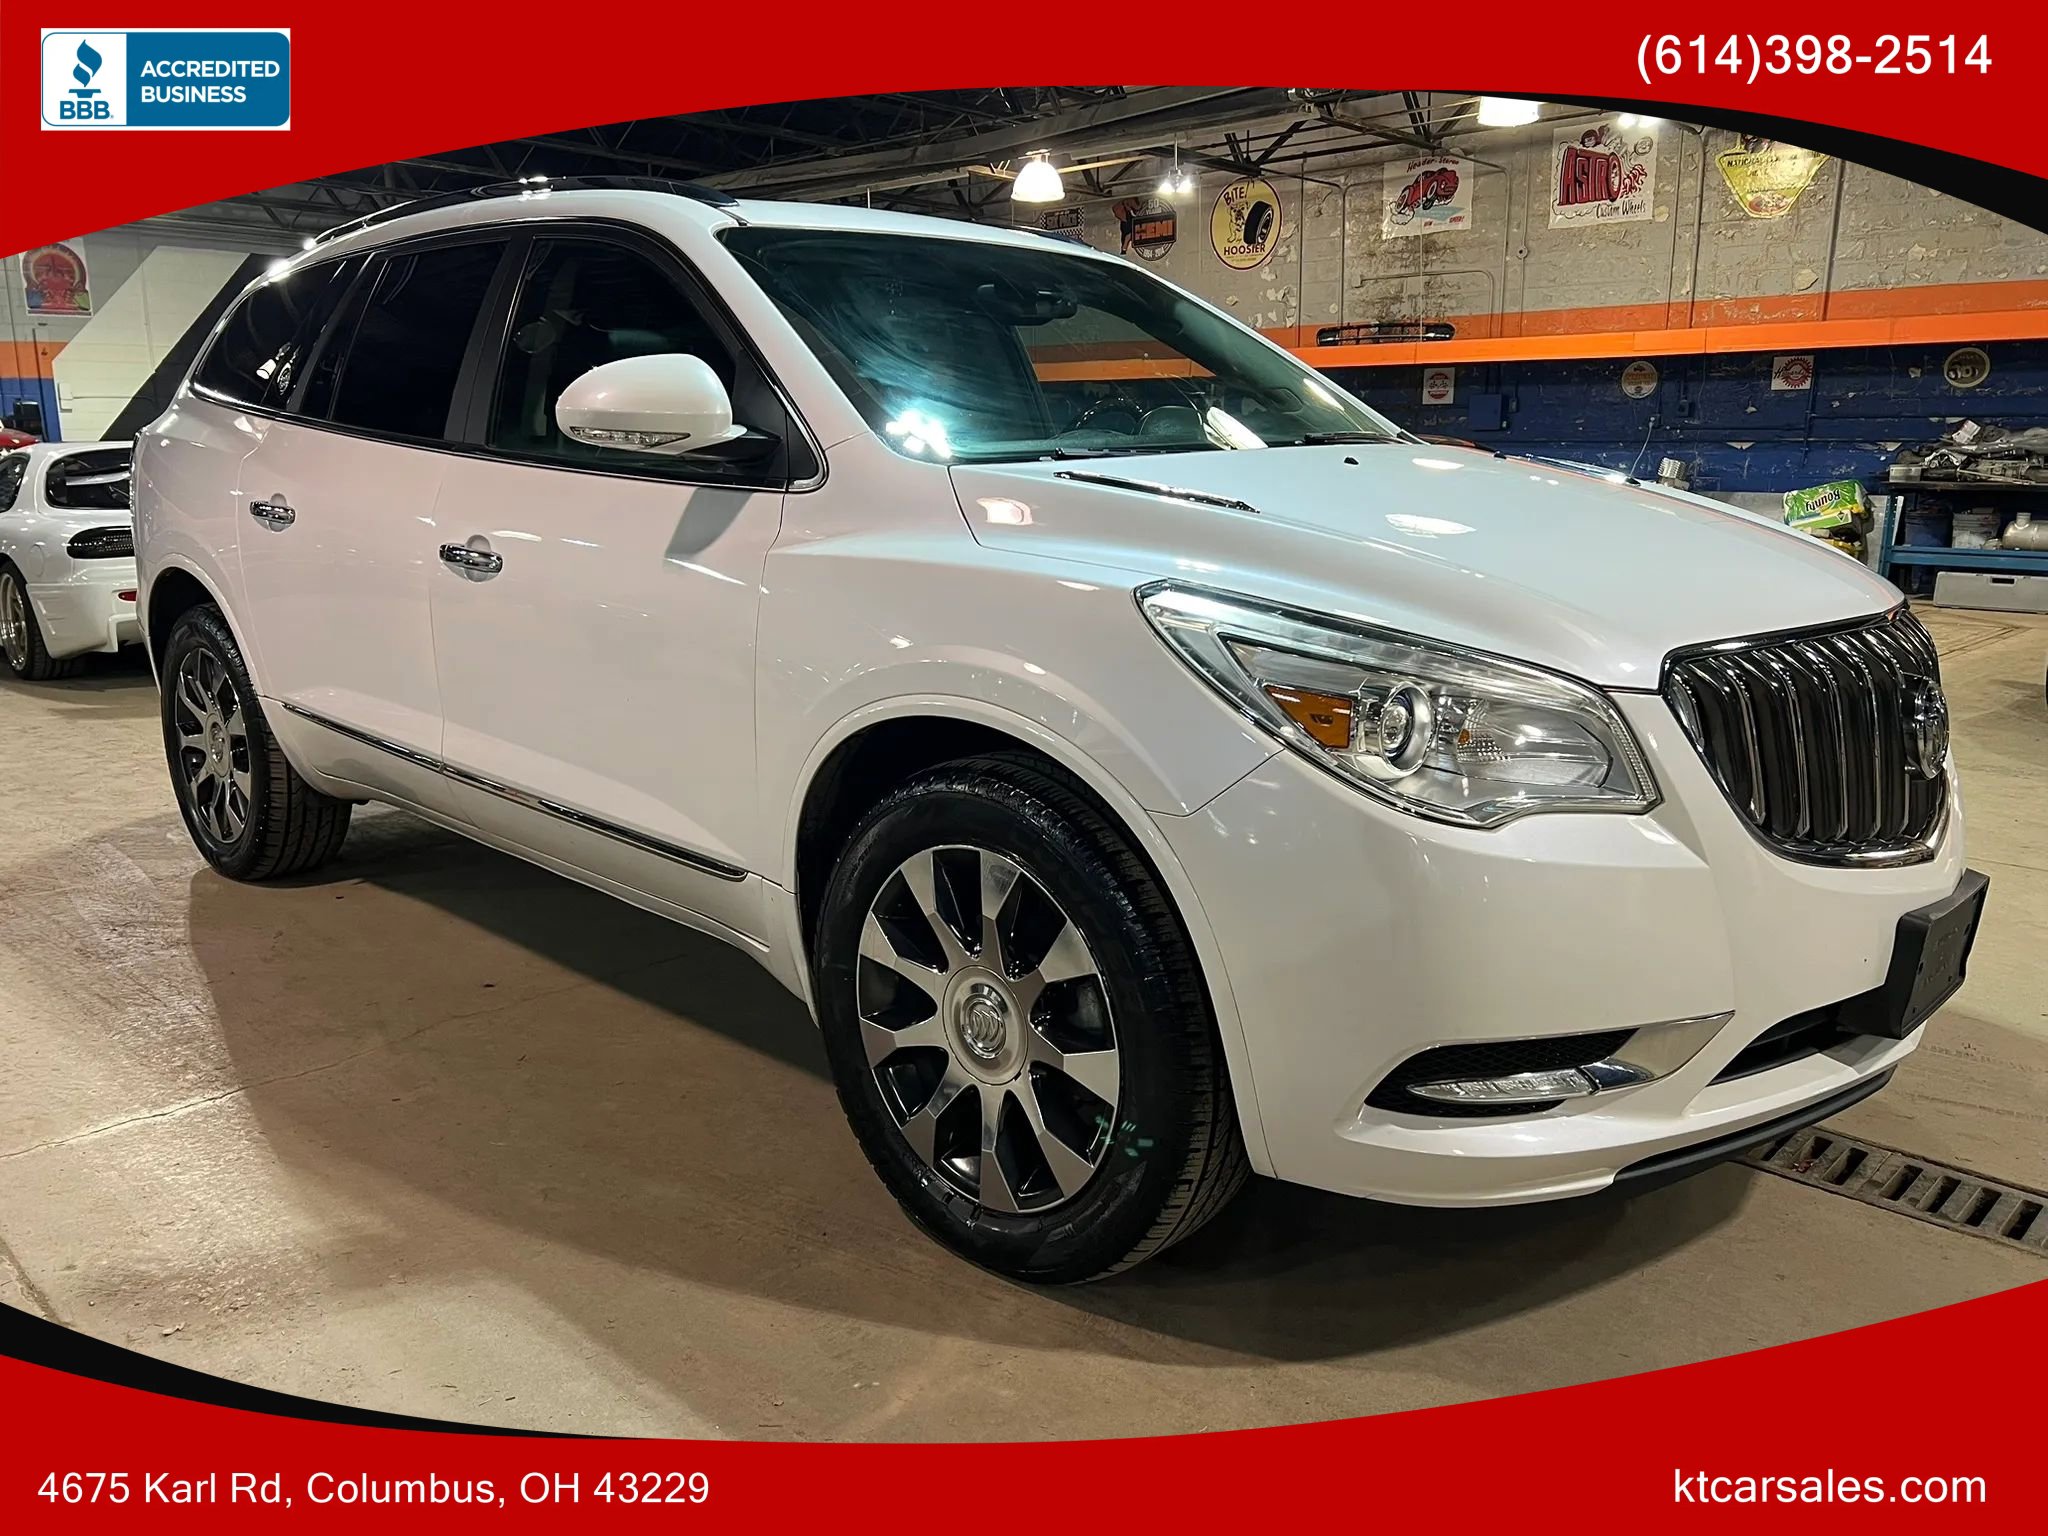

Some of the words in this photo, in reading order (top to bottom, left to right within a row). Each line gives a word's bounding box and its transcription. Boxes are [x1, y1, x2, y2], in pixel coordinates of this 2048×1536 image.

[1557, 145, 1621, 205] ASTRO
[1622, 200, 1646, 215] Wheels
[1134, 219, 1174, 241] HEMI
[1223, 243, 1266, 256] HOOSIER
[1806, 488, 1841, 512] Bounty
